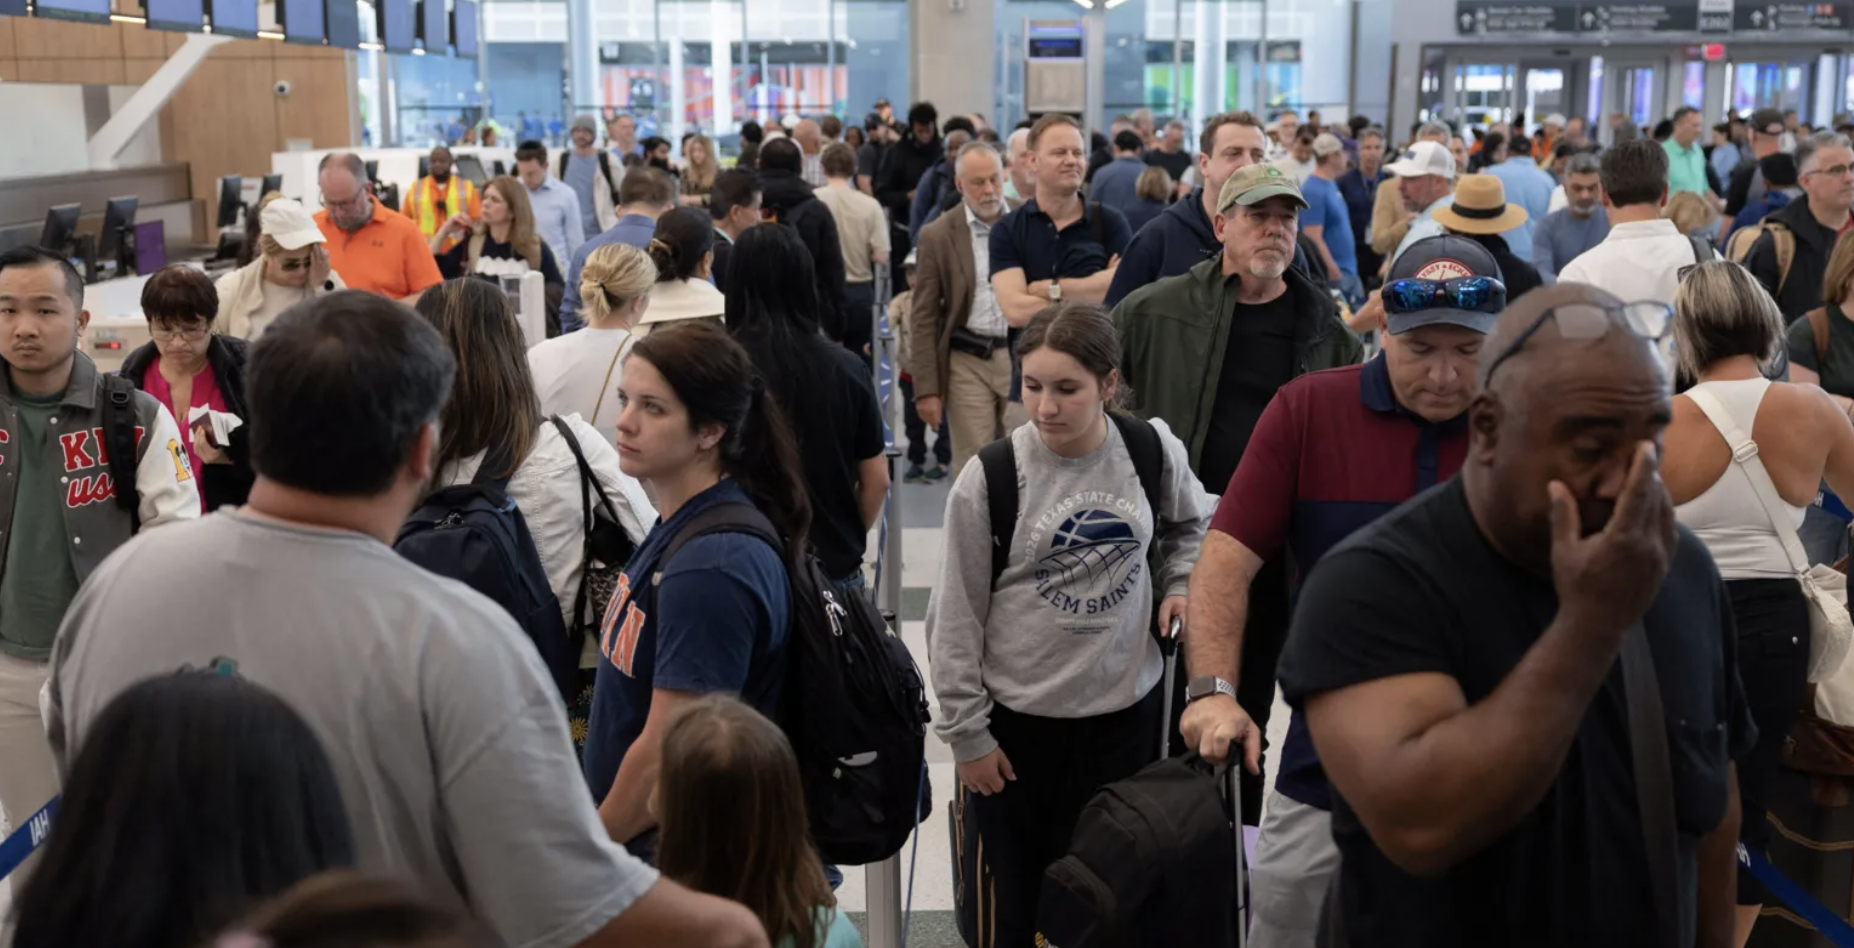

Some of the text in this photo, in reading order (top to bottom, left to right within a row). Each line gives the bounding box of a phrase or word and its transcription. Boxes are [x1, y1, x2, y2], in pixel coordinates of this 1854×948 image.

[1025, 531, 1040, 563] 2026
[1035, 498, 1073, 531] TEXAS
[1076, 491, 1114, 505] STATE
[1086, 563, 1141, 614] SAINTS
[29, 808, 50, 846] IAH
